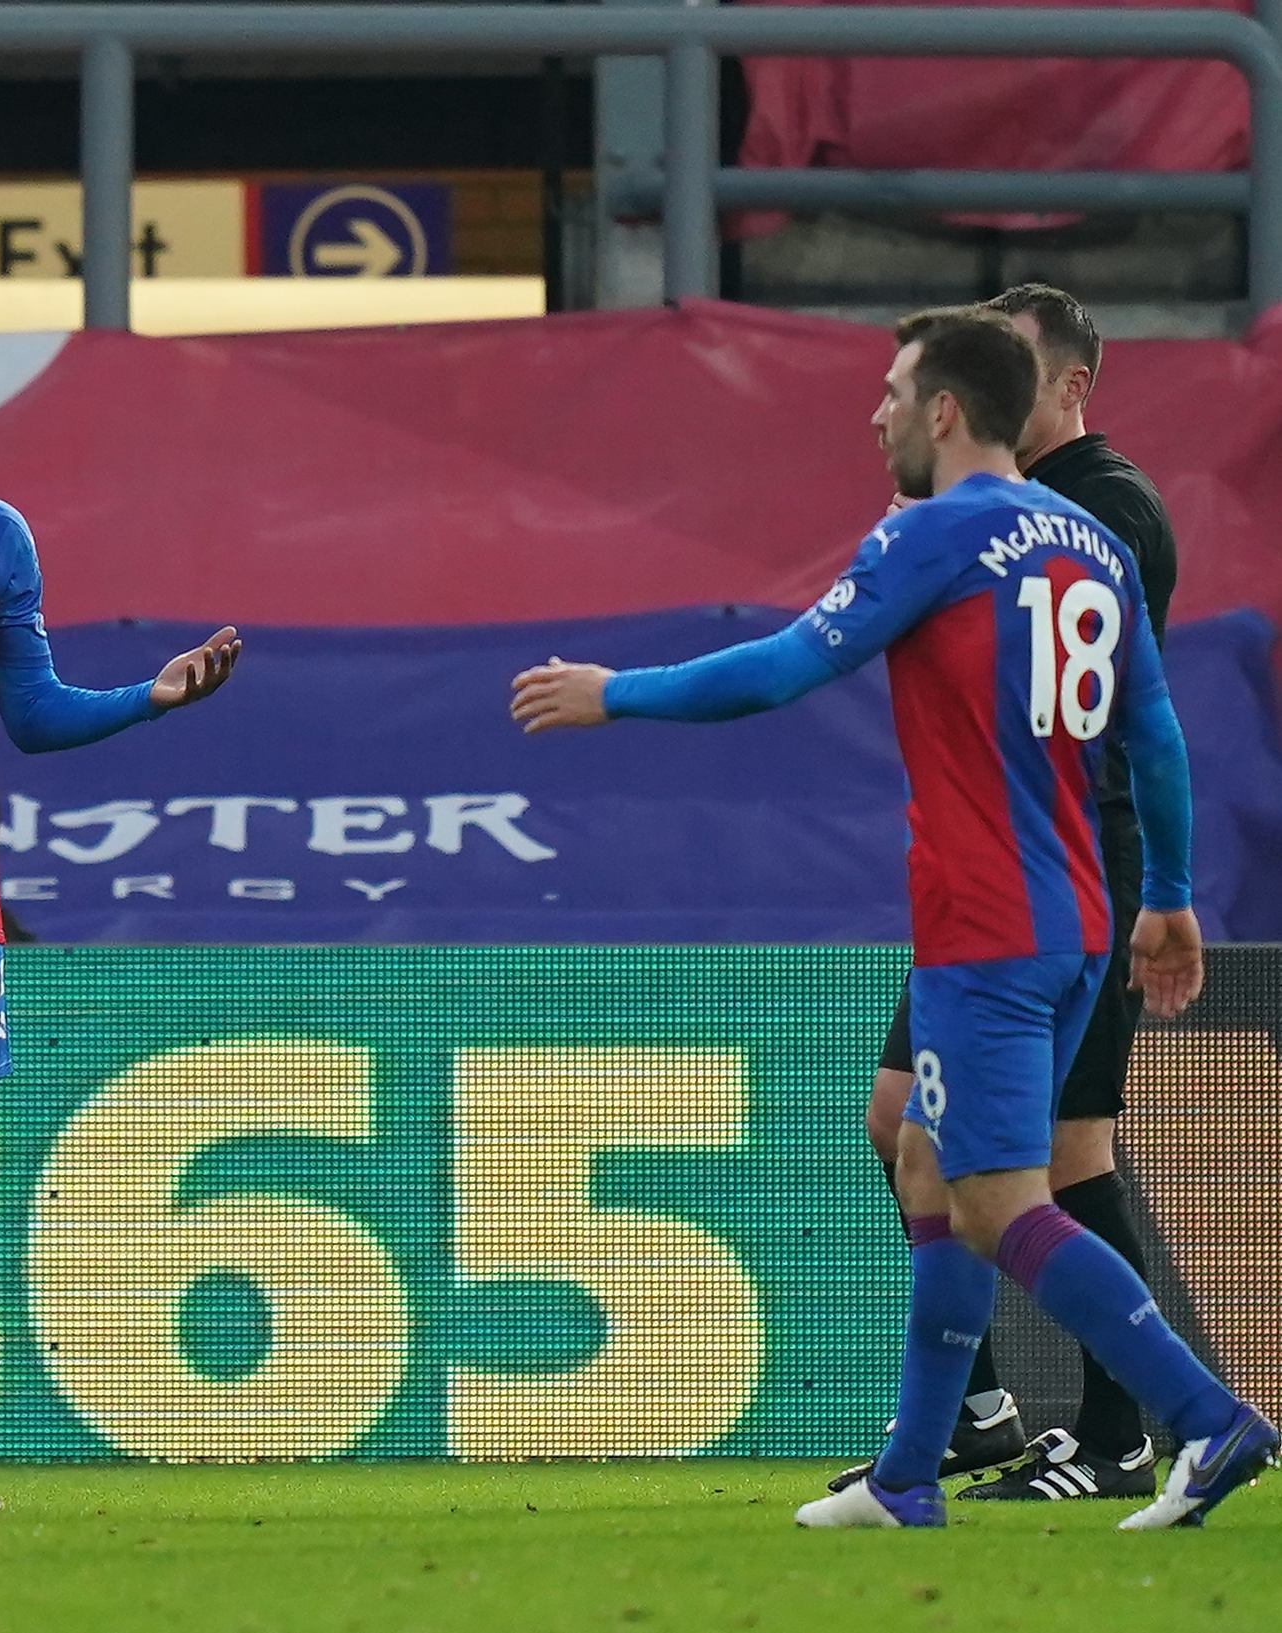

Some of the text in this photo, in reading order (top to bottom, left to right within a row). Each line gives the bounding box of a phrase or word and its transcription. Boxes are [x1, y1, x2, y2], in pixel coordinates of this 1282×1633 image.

[977, 511, 1126, 588] McARTHUR
[1016, 575, 1122, 742] 18
[913, 1048, 947, 1121] 8
